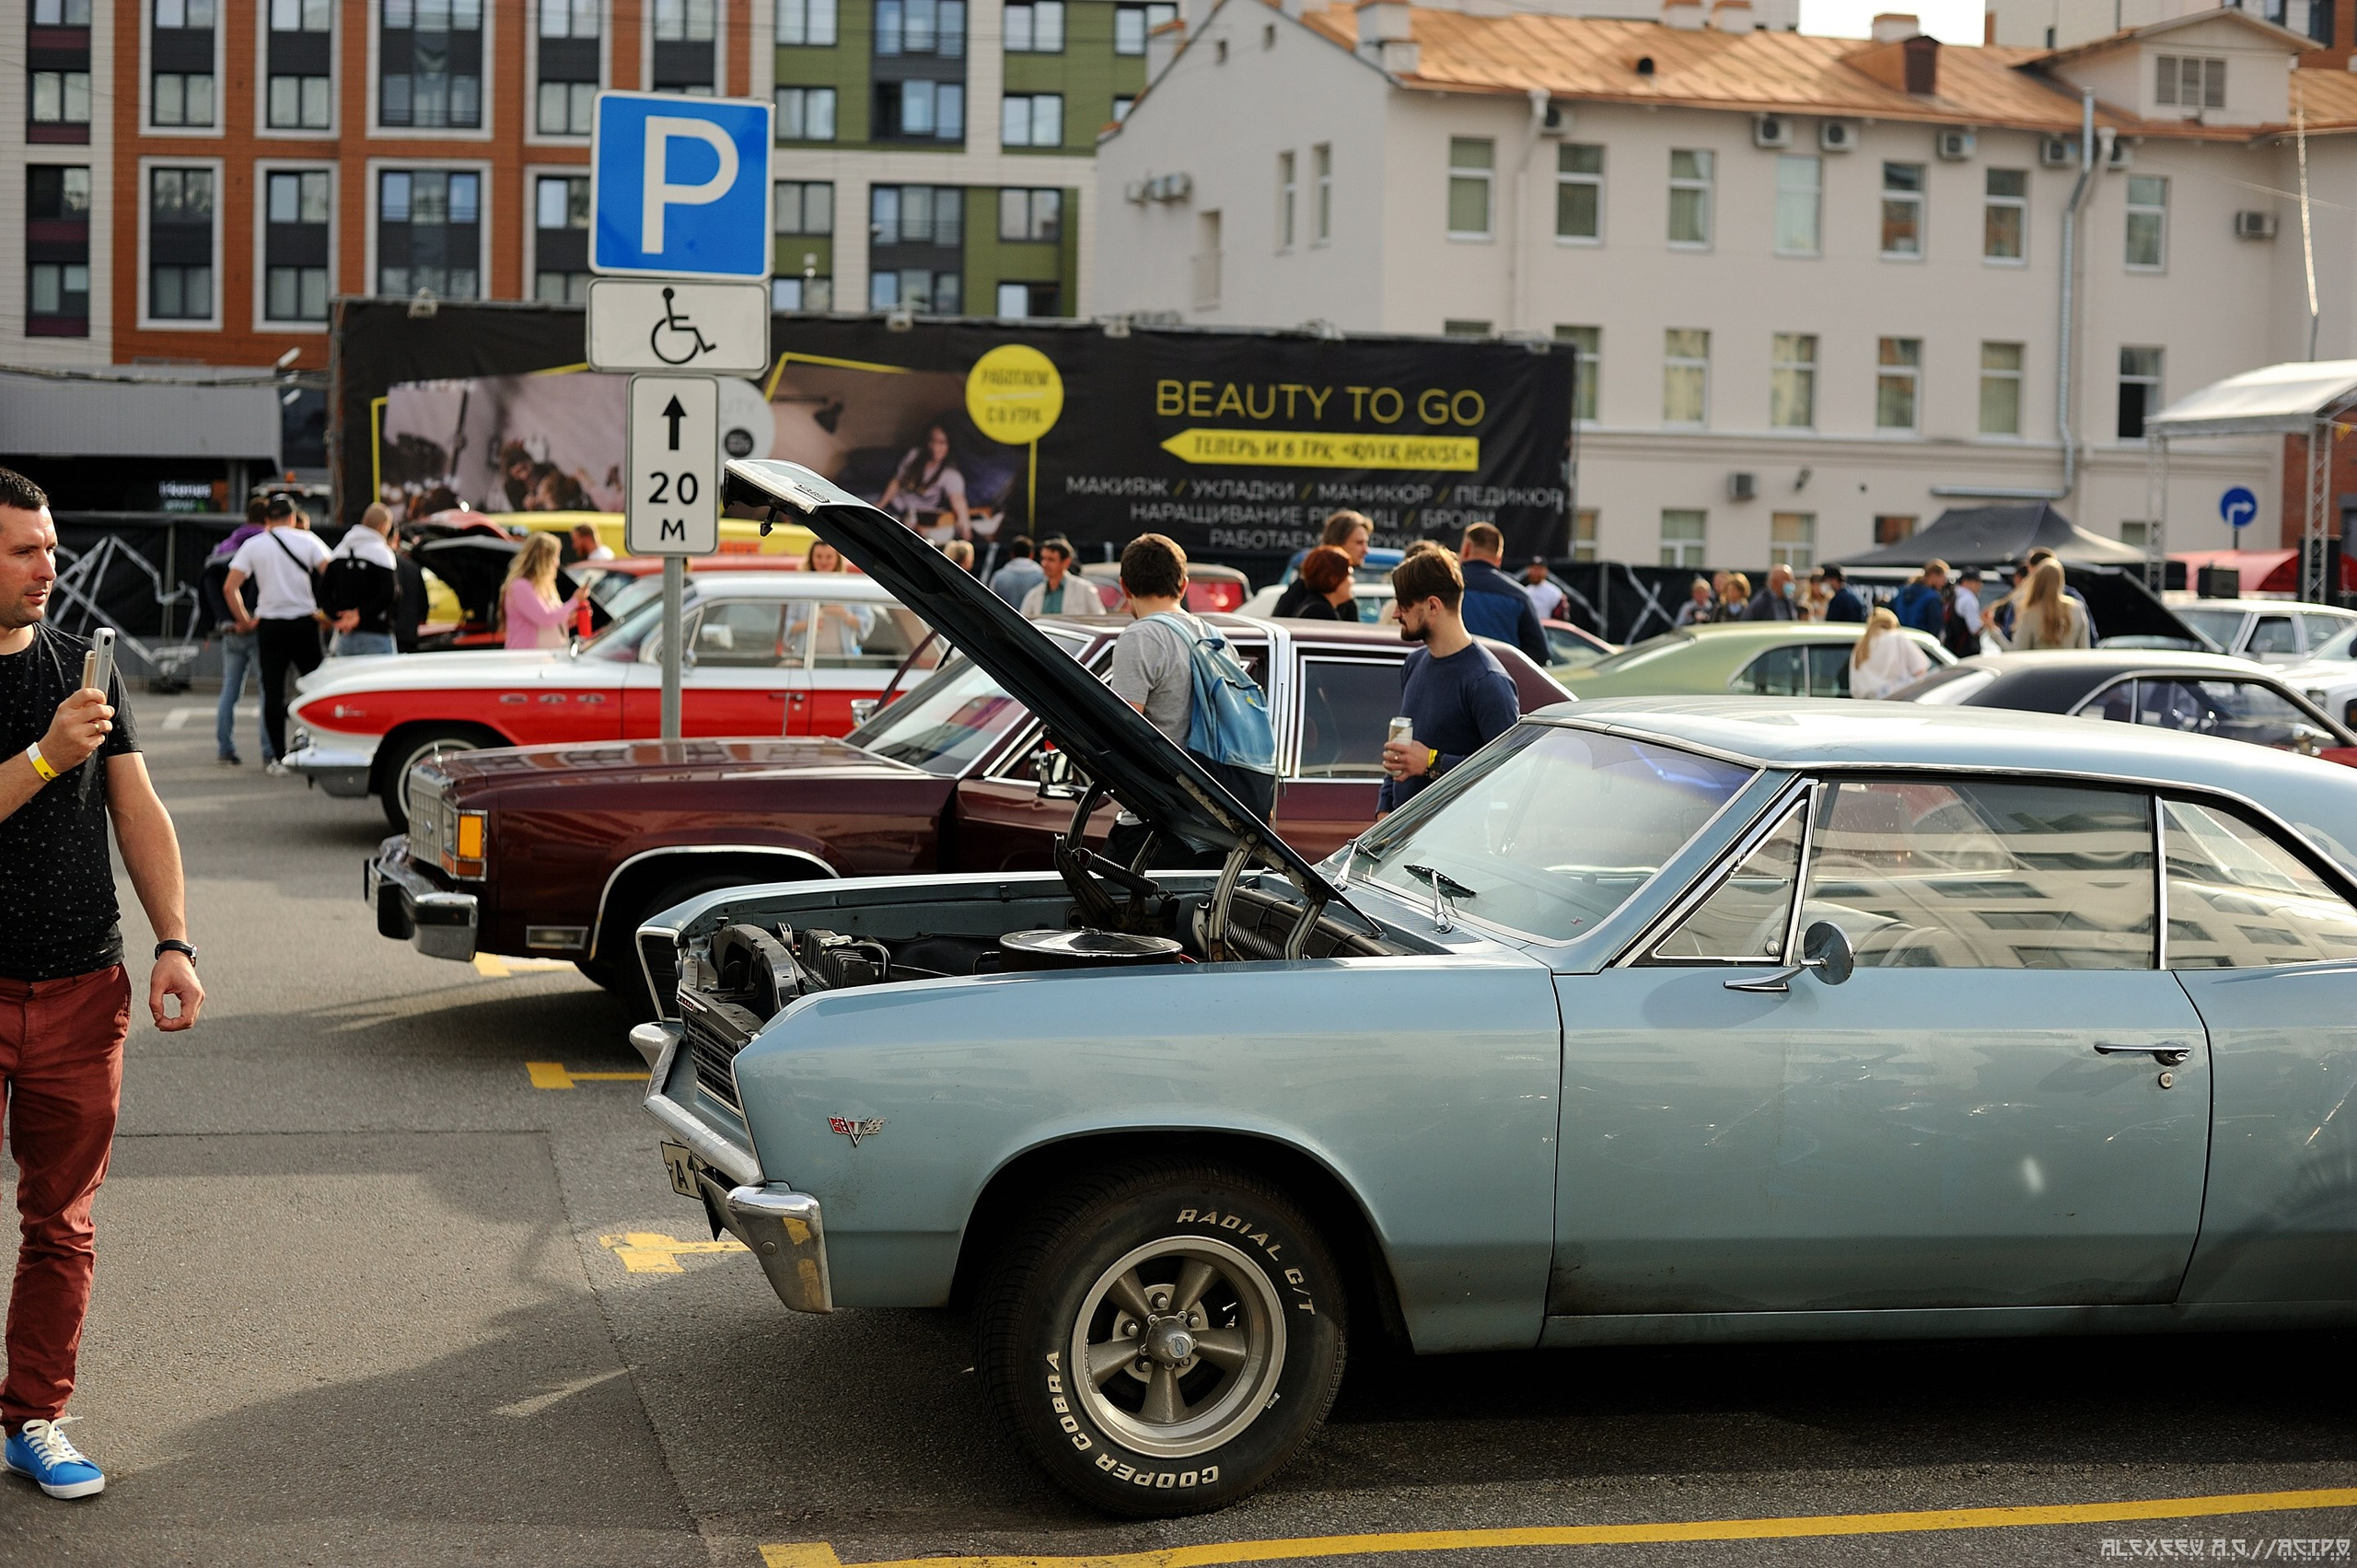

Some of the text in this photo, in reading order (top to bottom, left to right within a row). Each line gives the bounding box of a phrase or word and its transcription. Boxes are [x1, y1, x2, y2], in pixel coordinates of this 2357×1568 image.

[641, 115, 739, 254] P
[1155, 379, 1485, 427] BEAUTY TO GO
[1194, 436, 1260, 457] ТЕПЕРЬ
[648, 471, 699, 505] 20
[1066, 475, 1168, 496] МАКИЯЖ
[1190, 478, 1295, 501] УКЛАДКИ
[1317, 482, 1434, 505] МАНИКЮР
[1130, 502, 1303, 526] НАРАЩИВАНИЕ
[1176, 1209, 1287, 1261] RADIAL
[1284, 1268, 1316, 1316] G/T
[1046, 1352, 1219, 1489] COOPER COBRA
